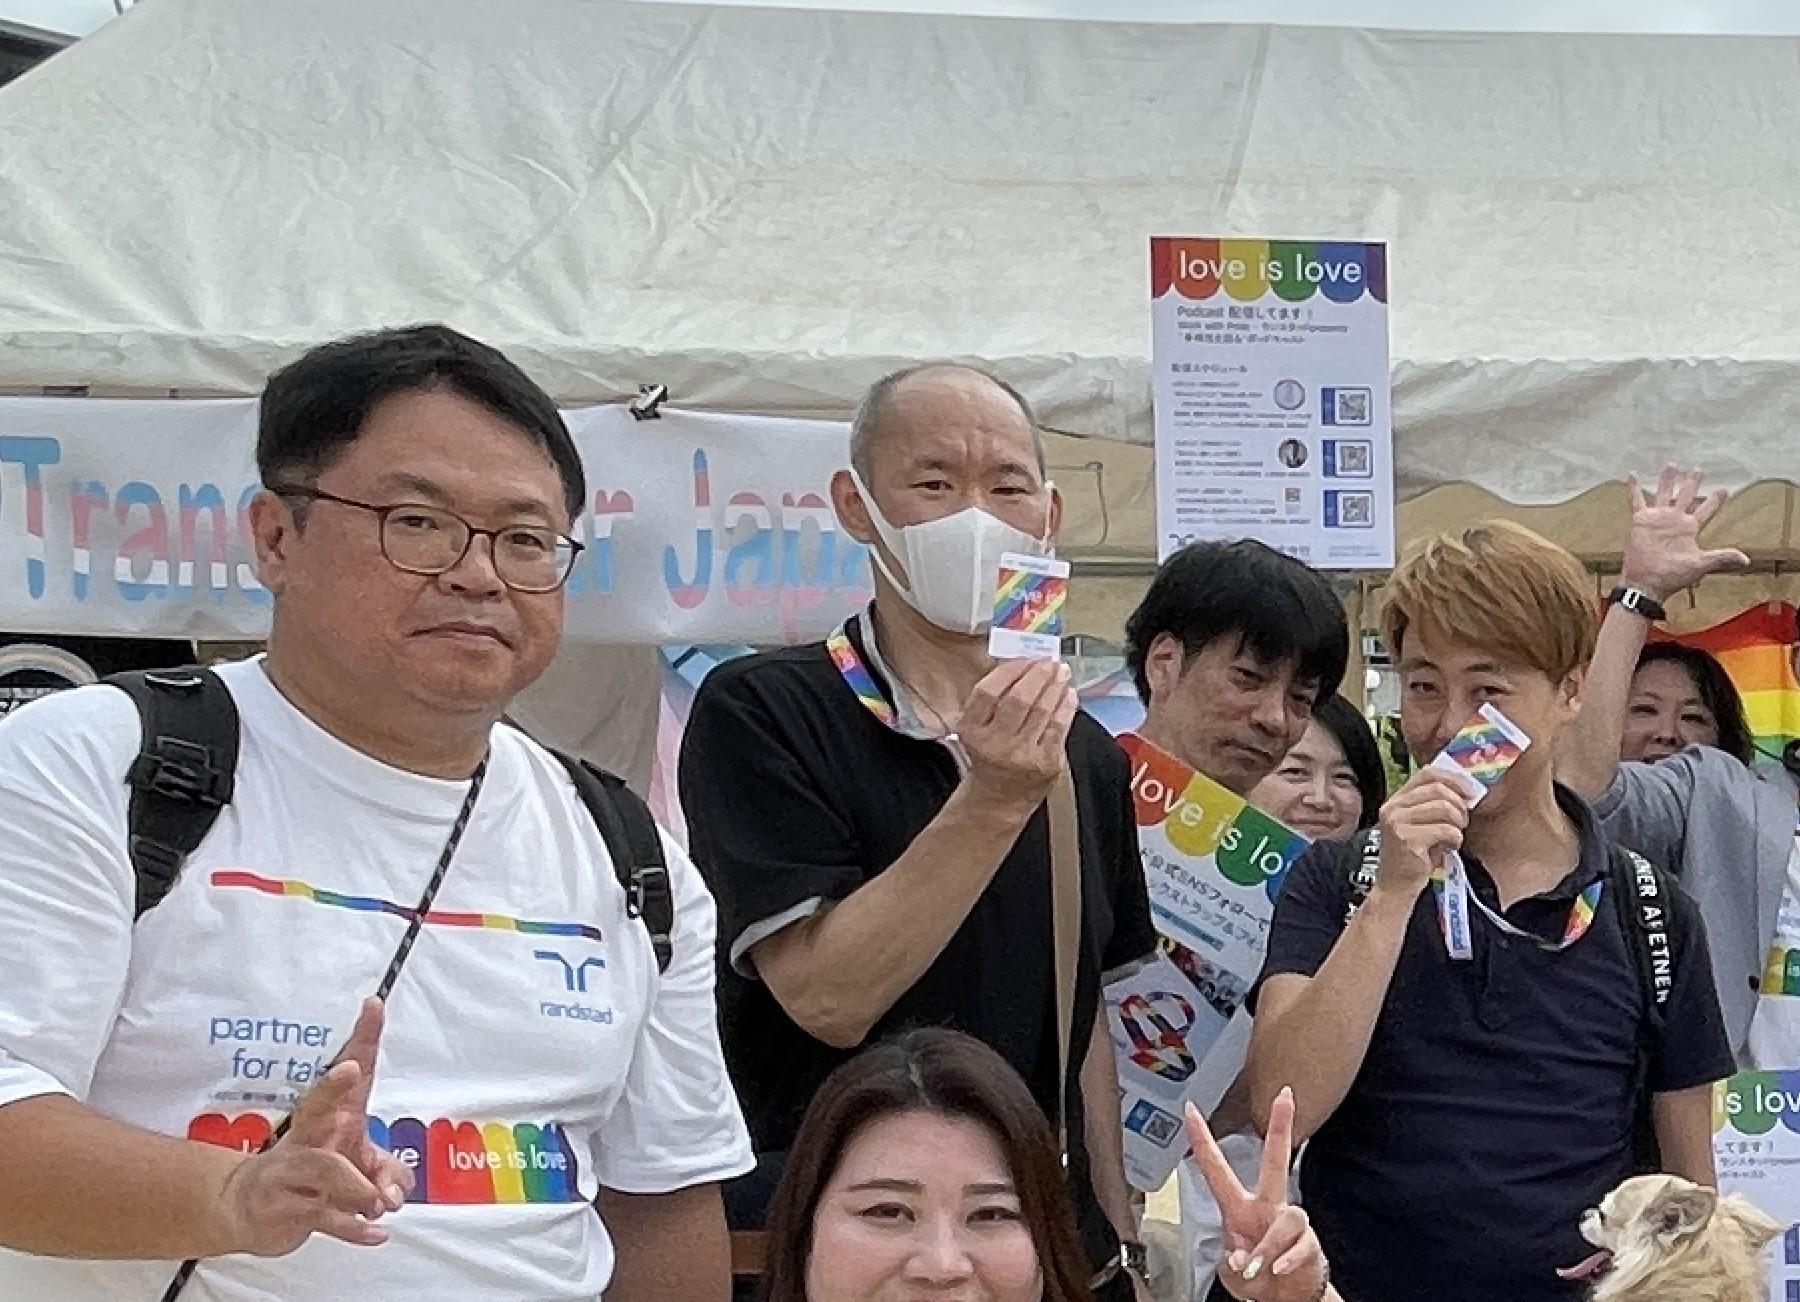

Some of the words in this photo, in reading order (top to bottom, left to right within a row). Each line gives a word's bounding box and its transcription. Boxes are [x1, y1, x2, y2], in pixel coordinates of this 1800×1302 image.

[1179, 249, 1246, 280] love
[1258, 256, 1283, 280] is
[1296, 252, 1362, 283] love
[1129, 761, 1204, 827] love
[1211, 813, 1243, 851] is
[1249, 835, 1292, 876] lo
[209, 1017, 333, 1047] partner
[232, 1048, 280, 1080] for
[1715, 1089, 1743, 1113] is
[449, 1143, 502, 1170] love
[507, 1142, 527, 1170] is
